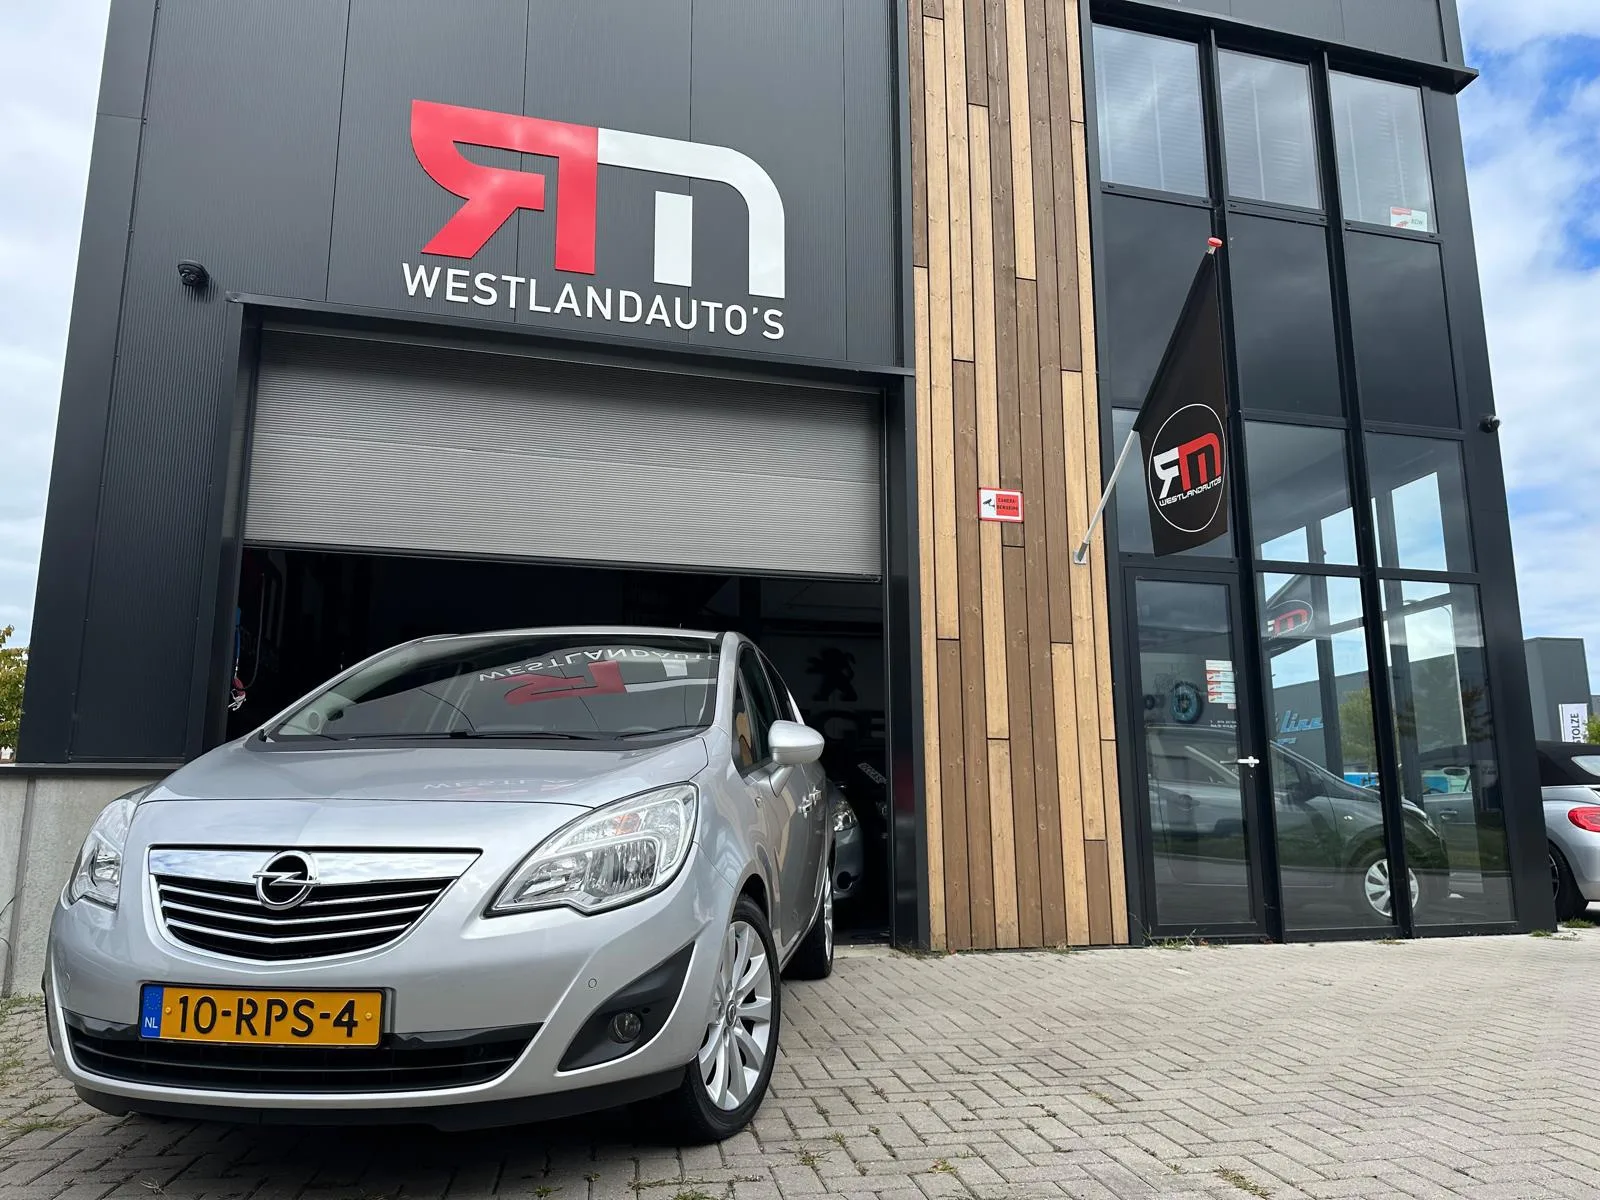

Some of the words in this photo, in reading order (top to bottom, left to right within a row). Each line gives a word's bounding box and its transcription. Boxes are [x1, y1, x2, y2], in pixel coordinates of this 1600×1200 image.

[402, 262, 785, 340] WESTLANDAUTO'S
[144, 1017, 158, 1029] NL
[178, 994, 359, 1038] 10-RPS-4
